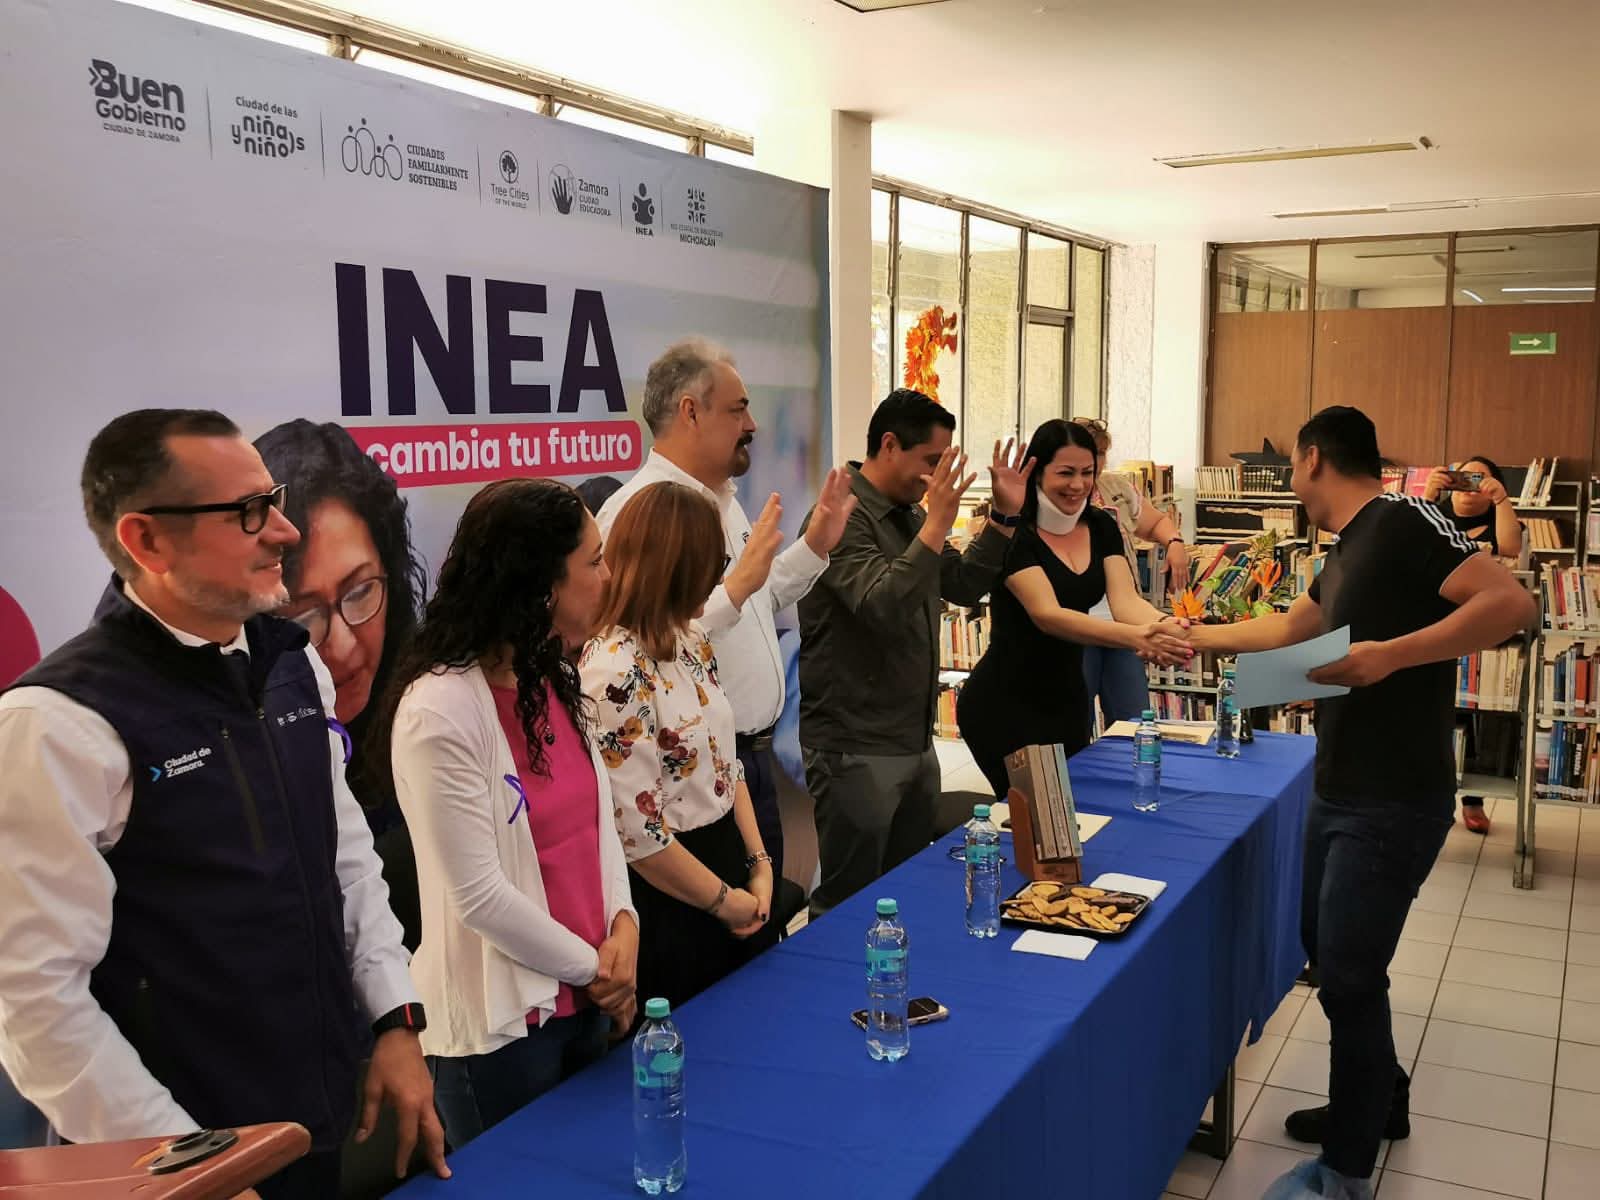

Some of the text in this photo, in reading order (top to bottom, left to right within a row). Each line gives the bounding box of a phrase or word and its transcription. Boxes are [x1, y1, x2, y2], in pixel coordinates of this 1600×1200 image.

[92, 58, 185, 114] Buen
[96, 98, 186, 132] Gobierno
[235, 96, 298, 119] Ciudad de las
[406, 144, 446, 161] CIUDADES
[408, 158, 469, 180] FAMILIARMENTE
[408, 173, 458, 191] SOSTENIBLES
[490, 183, 530, 201] Tree Cities
[578, 178, 609, 197] Zamora
[635, 226, 654, 237] INEA
[335, 262, 628, 416] INEA
[366, 428, 633, 474] cambia tu futuro
[164, 747, 211, 768] Ciudad de
